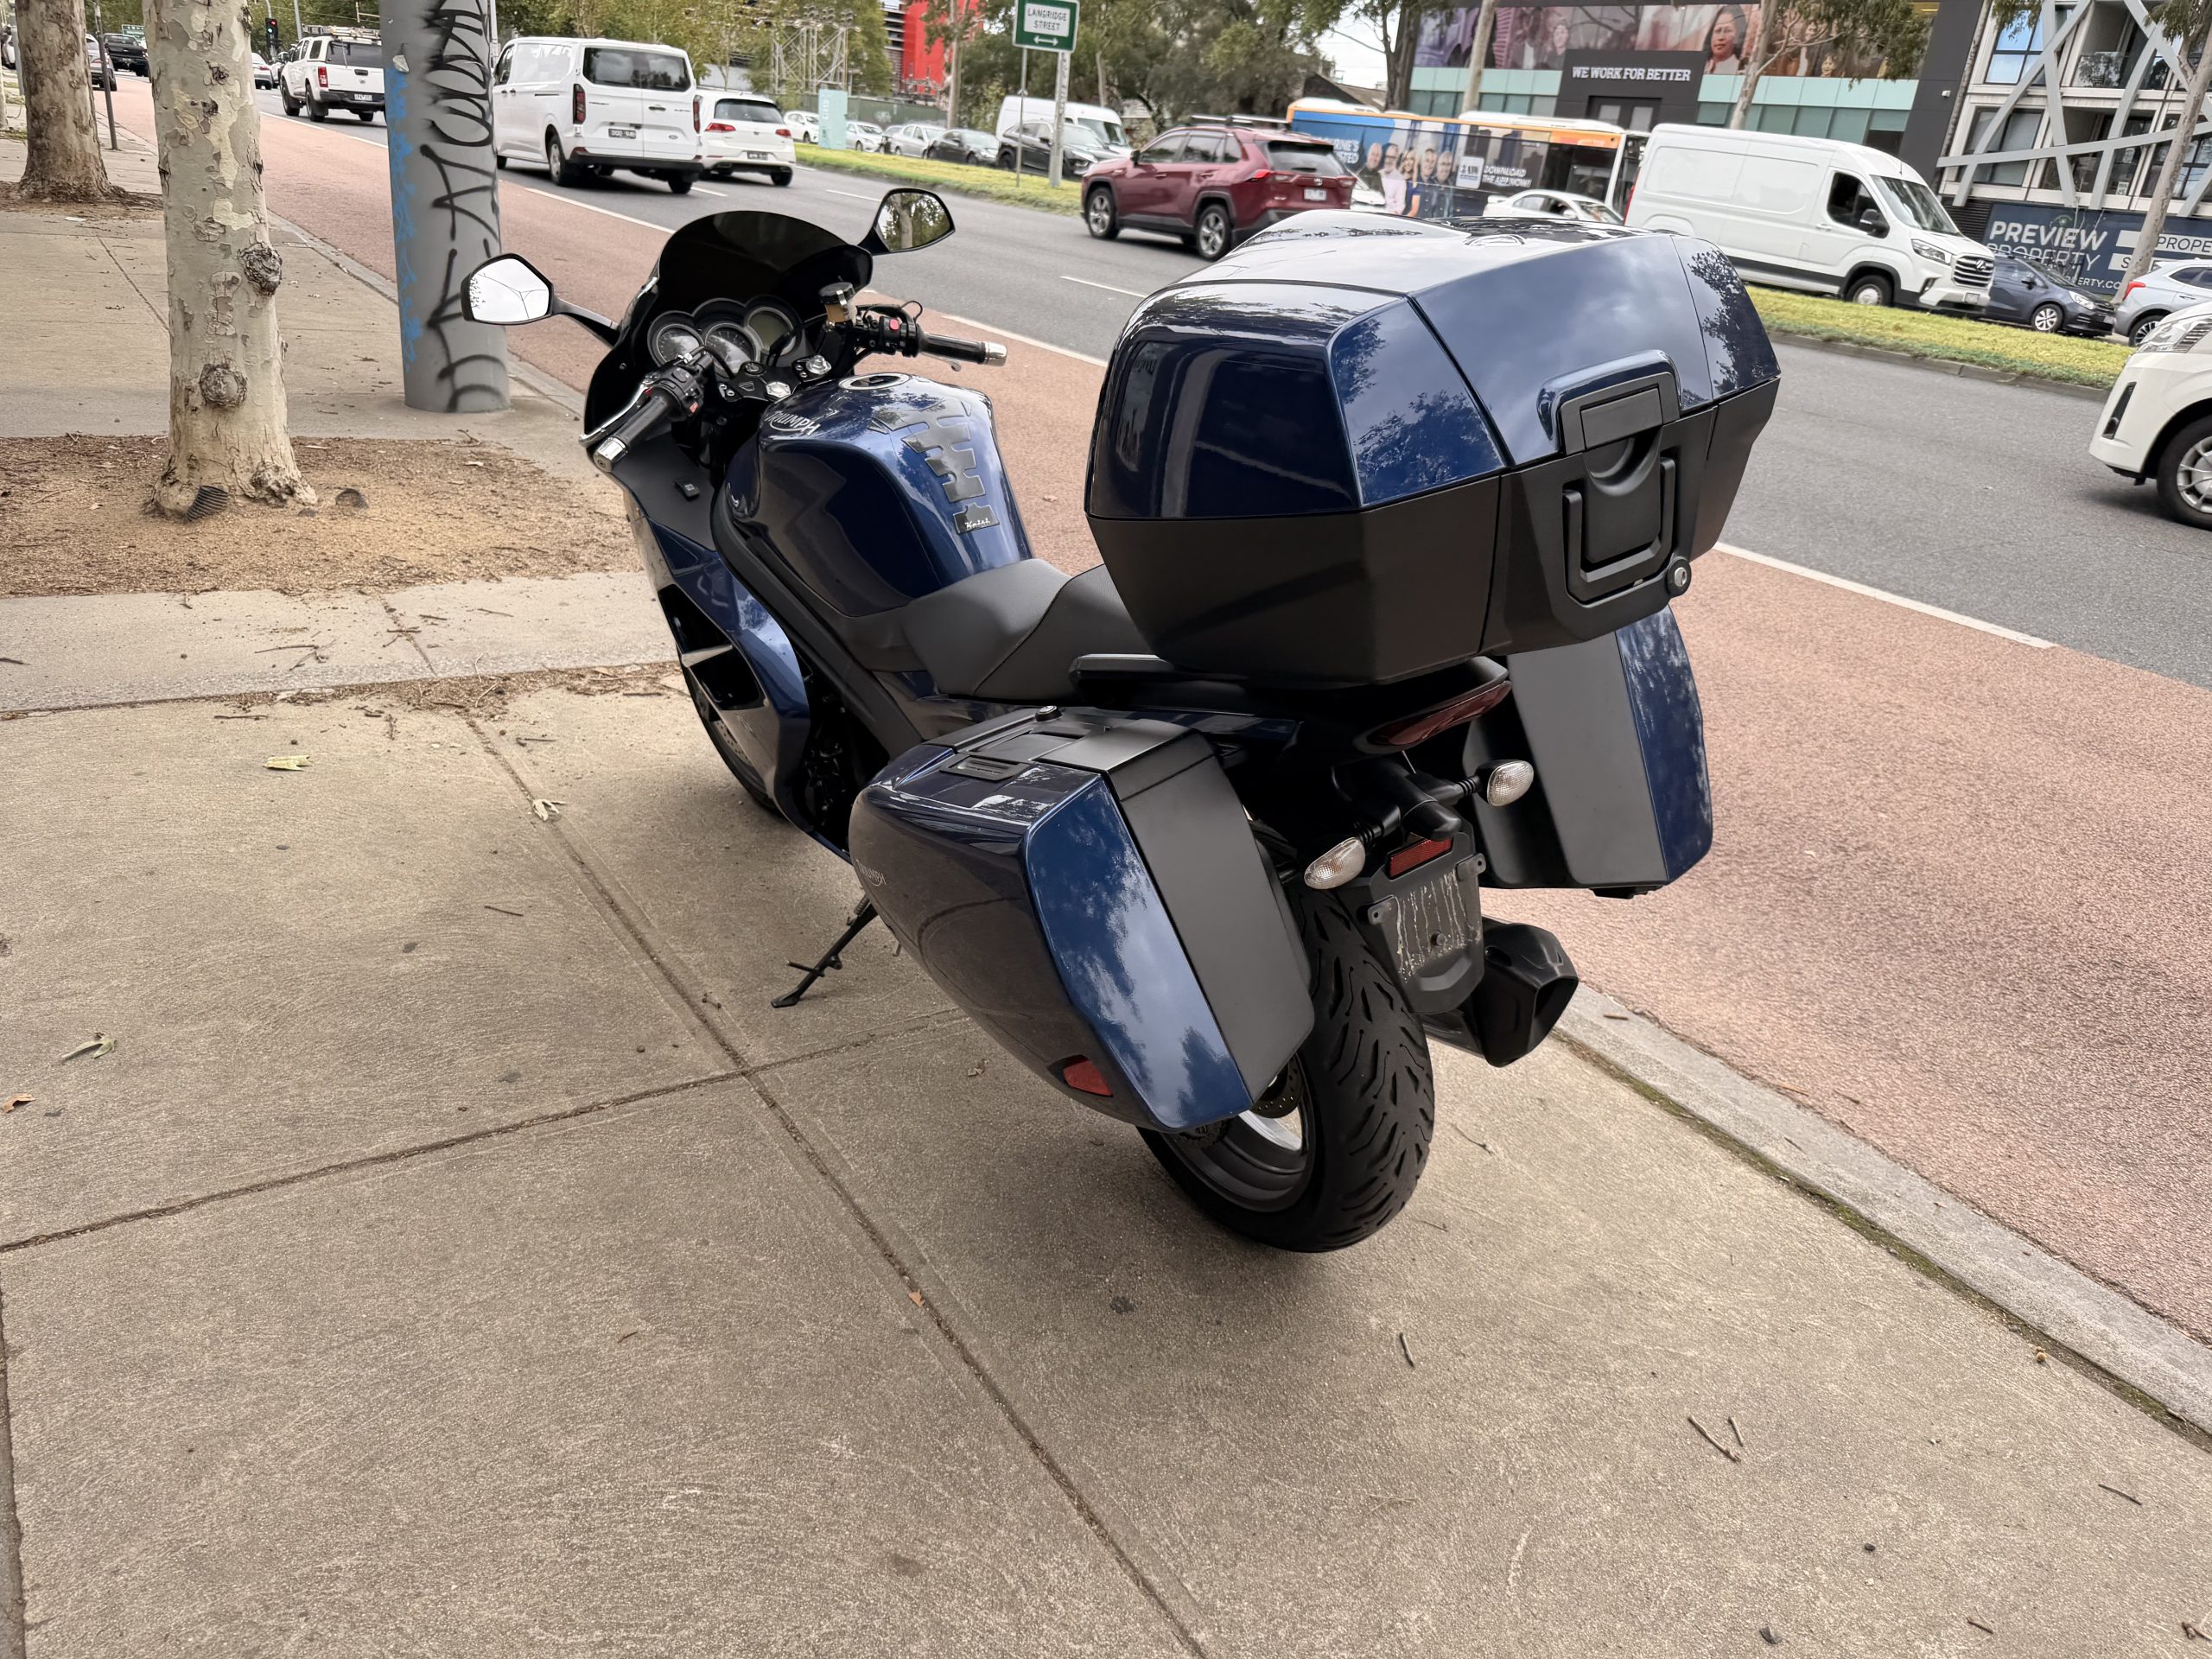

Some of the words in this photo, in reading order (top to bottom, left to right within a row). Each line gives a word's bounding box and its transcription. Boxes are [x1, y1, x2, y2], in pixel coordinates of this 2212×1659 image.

[1033, 20, 1061, 31] STREET
[1572, 67, 1590, 79] WE
[1590, 67, 1623, 79] WORK
[1623, 67, 1646, 80] FOR
[1645, 68, 1692, 81] BETTER
[1989, 220, 2108, 251] PREVIEW
[764, 410, 821, 436] TRIUMPH
